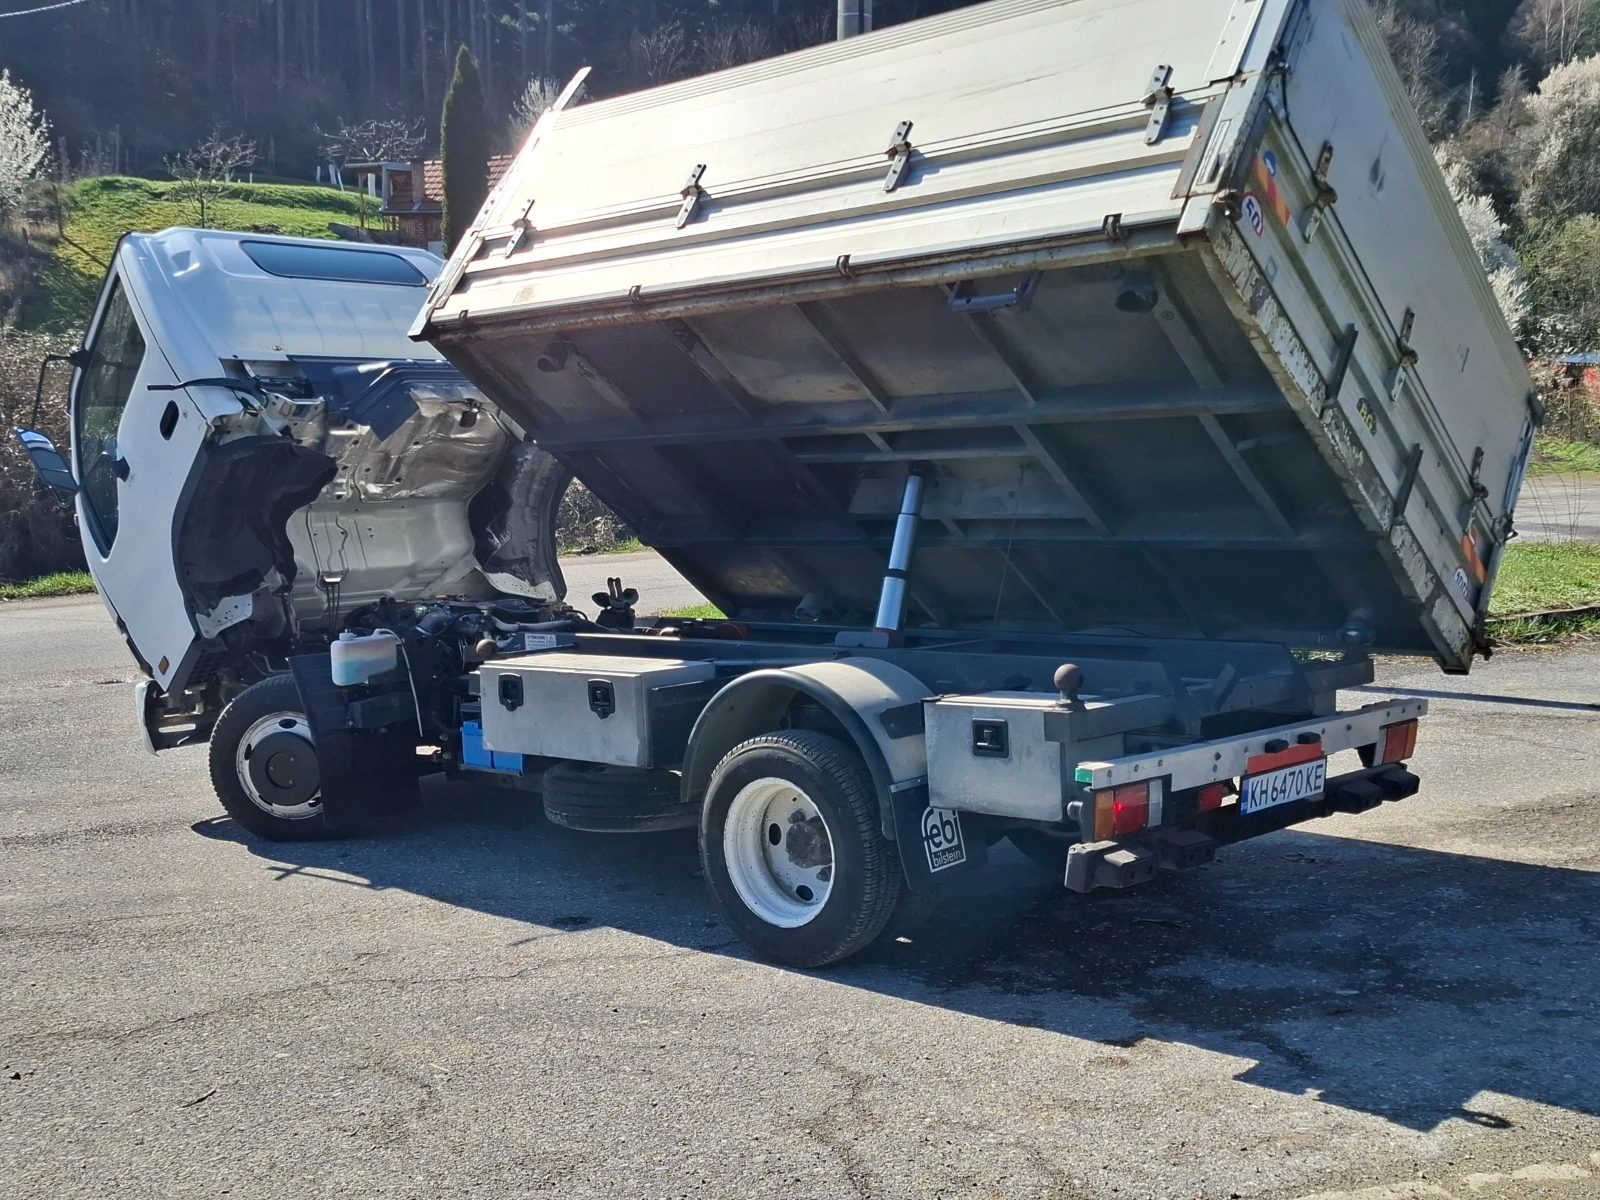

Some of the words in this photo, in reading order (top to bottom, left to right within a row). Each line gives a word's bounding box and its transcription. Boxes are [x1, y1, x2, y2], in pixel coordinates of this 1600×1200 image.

[1246, 198, 1260, 228] 50
[1360, 402, 1373, 429] BG
[932, 848, 961, 867] bilstein
